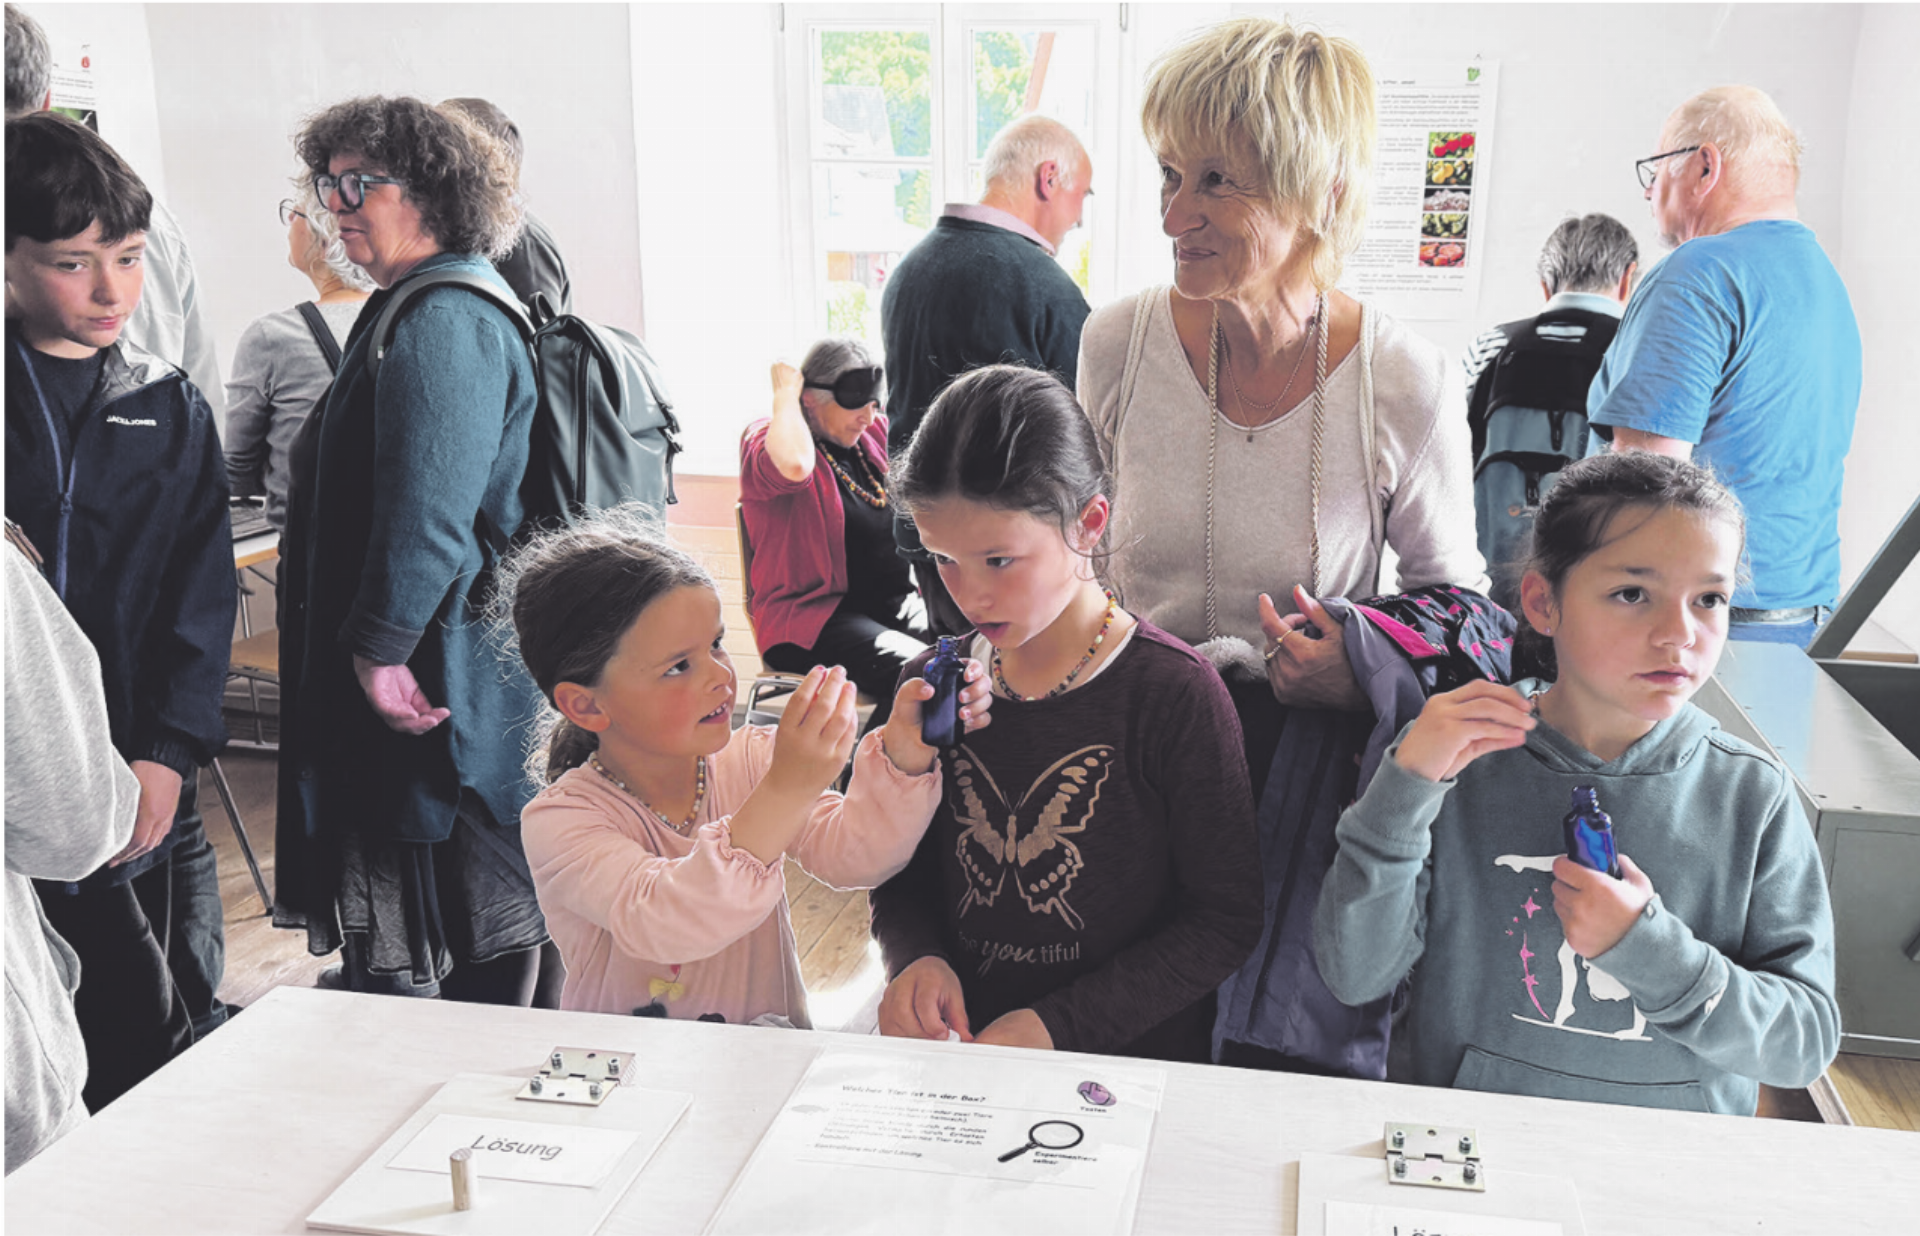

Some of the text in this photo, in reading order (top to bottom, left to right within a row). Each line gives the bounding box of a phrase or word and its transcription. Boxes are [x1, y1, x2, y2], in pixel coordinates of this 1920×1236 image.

[977, 940, 1037, 978] you
[1041, 941, 1080, 964] tiful
[842, 1085, 882, 1094] Welches
[888, 1088, 908, 1096] Tier
[960, 1094, 986, 1103] Box?
[470, 1134, 563, 1161] Lösung
[1034, 1151, 1098, 1162] Experimentiere
